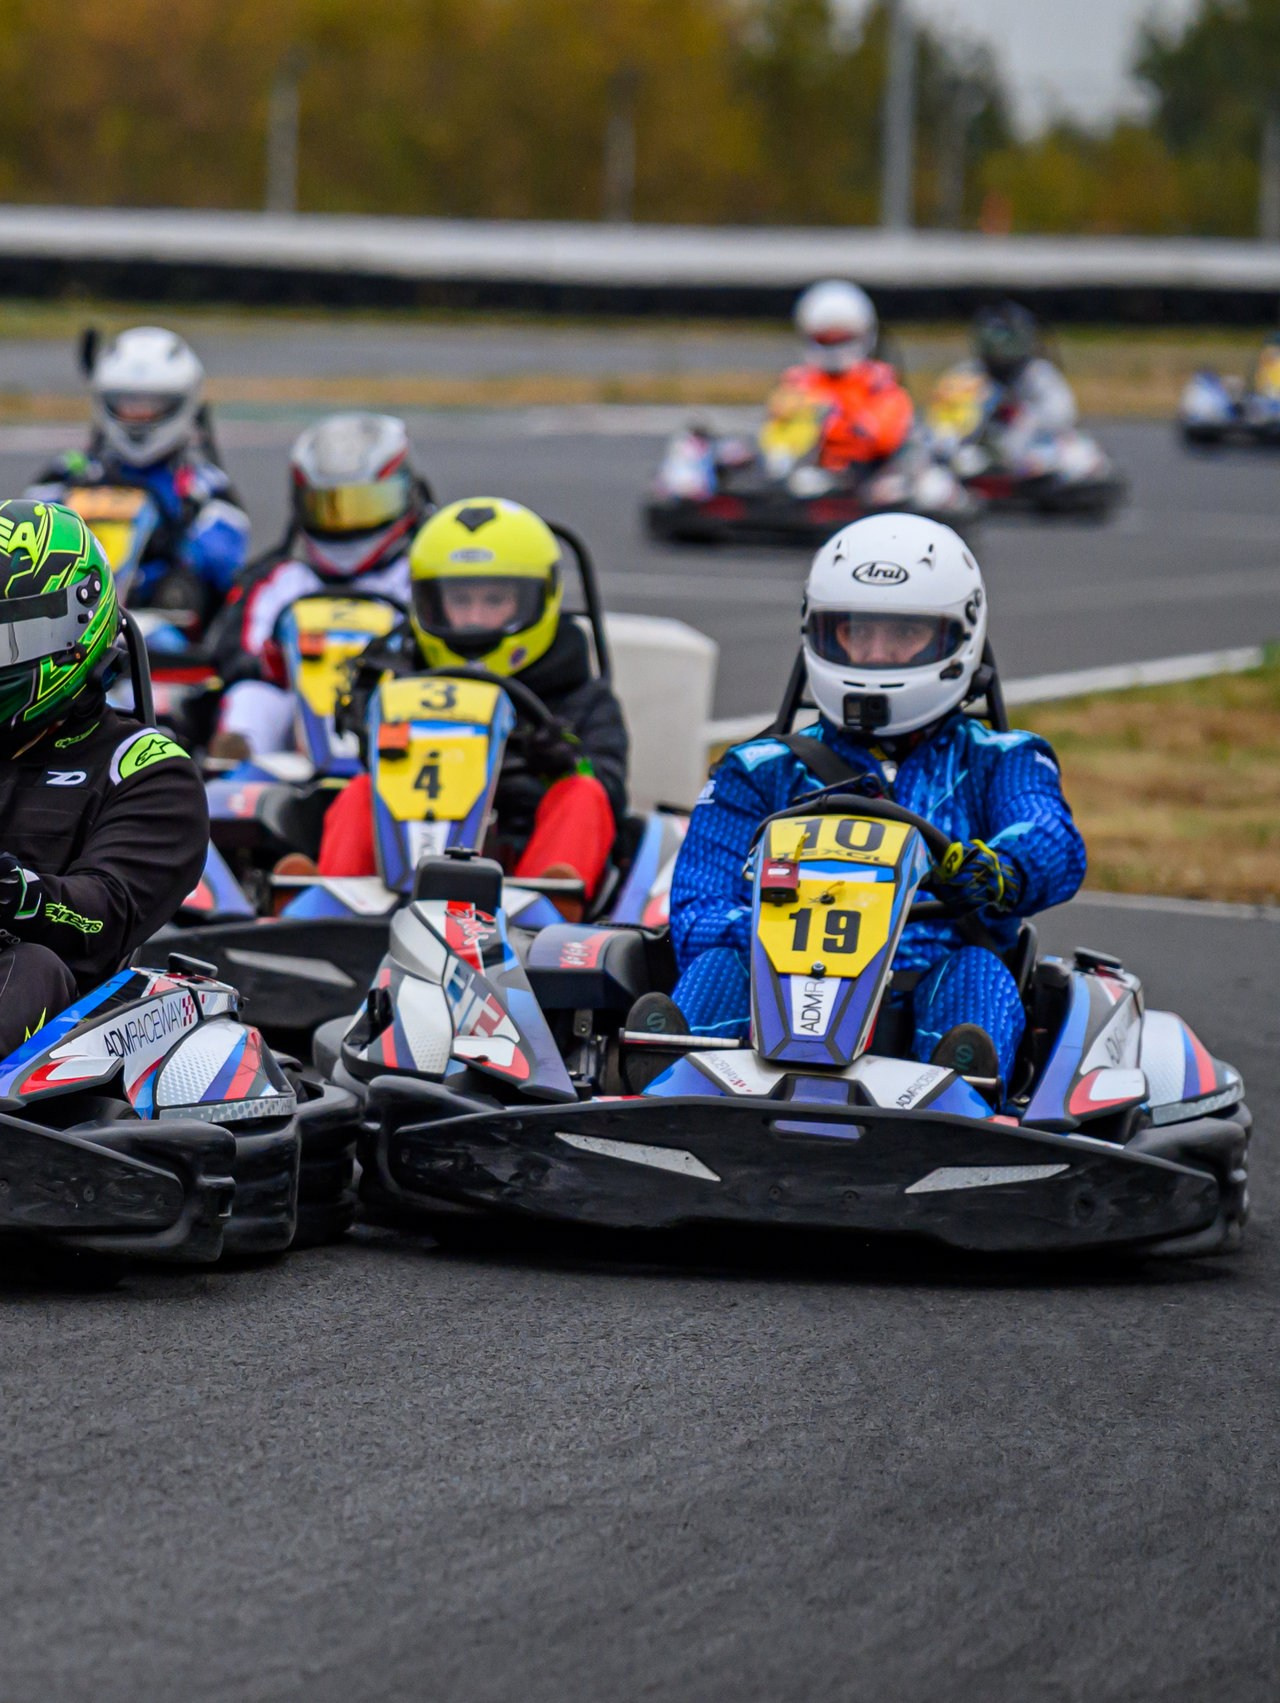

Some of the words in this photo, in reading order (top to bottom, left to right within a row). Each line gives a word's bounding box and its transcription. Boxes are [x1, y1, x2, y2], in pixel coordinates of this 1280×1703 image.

[855, 562, 904, 581] Arai
[420, 681, 457, 711] 3
[412, 763, 442, 800] 4
[795, 818, 886, 852] 10
[789, 908, 861, 953] 19
[103, 998, 183, 1058] ADMRACEWAY
